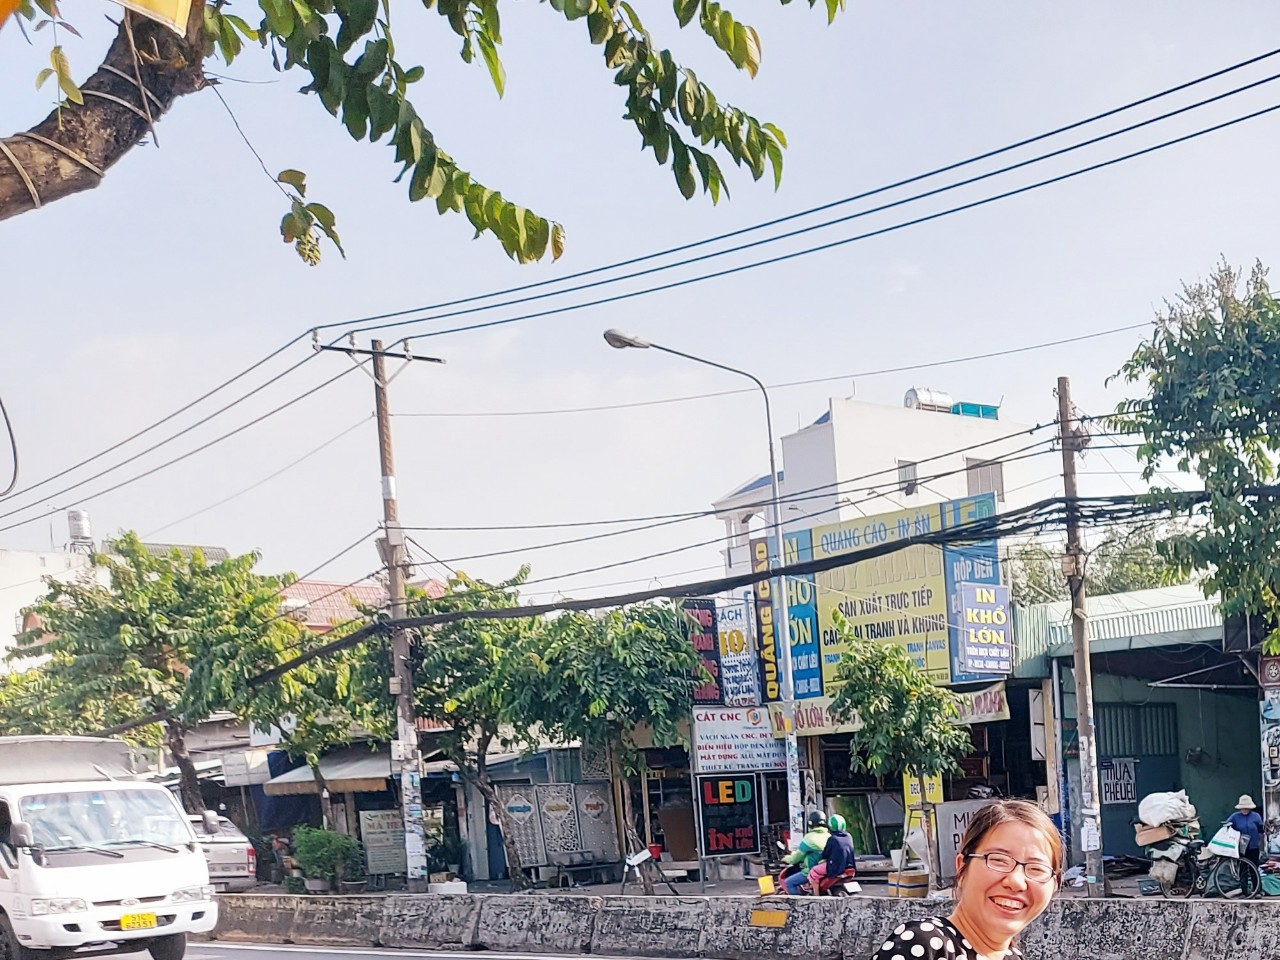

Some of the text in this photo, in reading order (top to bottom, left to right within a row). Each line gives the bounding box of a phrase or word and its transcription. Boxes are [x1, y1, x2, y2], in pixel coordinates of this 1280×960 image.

[838, 596, 857, 618] SẢN
[859, 591, 882, 615] XUẤT
[911, 584, 933, 607] TIẾP
[975, 587, 996, 604] IN
[966, 604, 1007, 625] KHỔ
[865, 620, 896, 639] TRANH
[897, 614, 910, 636] VÀ
[912, 613, 945, 634] KHUNG
[969, 626, 1006, 645] LỚN
[760, 606, 779, 699] QUẢNG
[720, 712, 741, 721] CNC
[1106, 761, 1133, 781] MUA
[703, 780, 752, 805] LED
